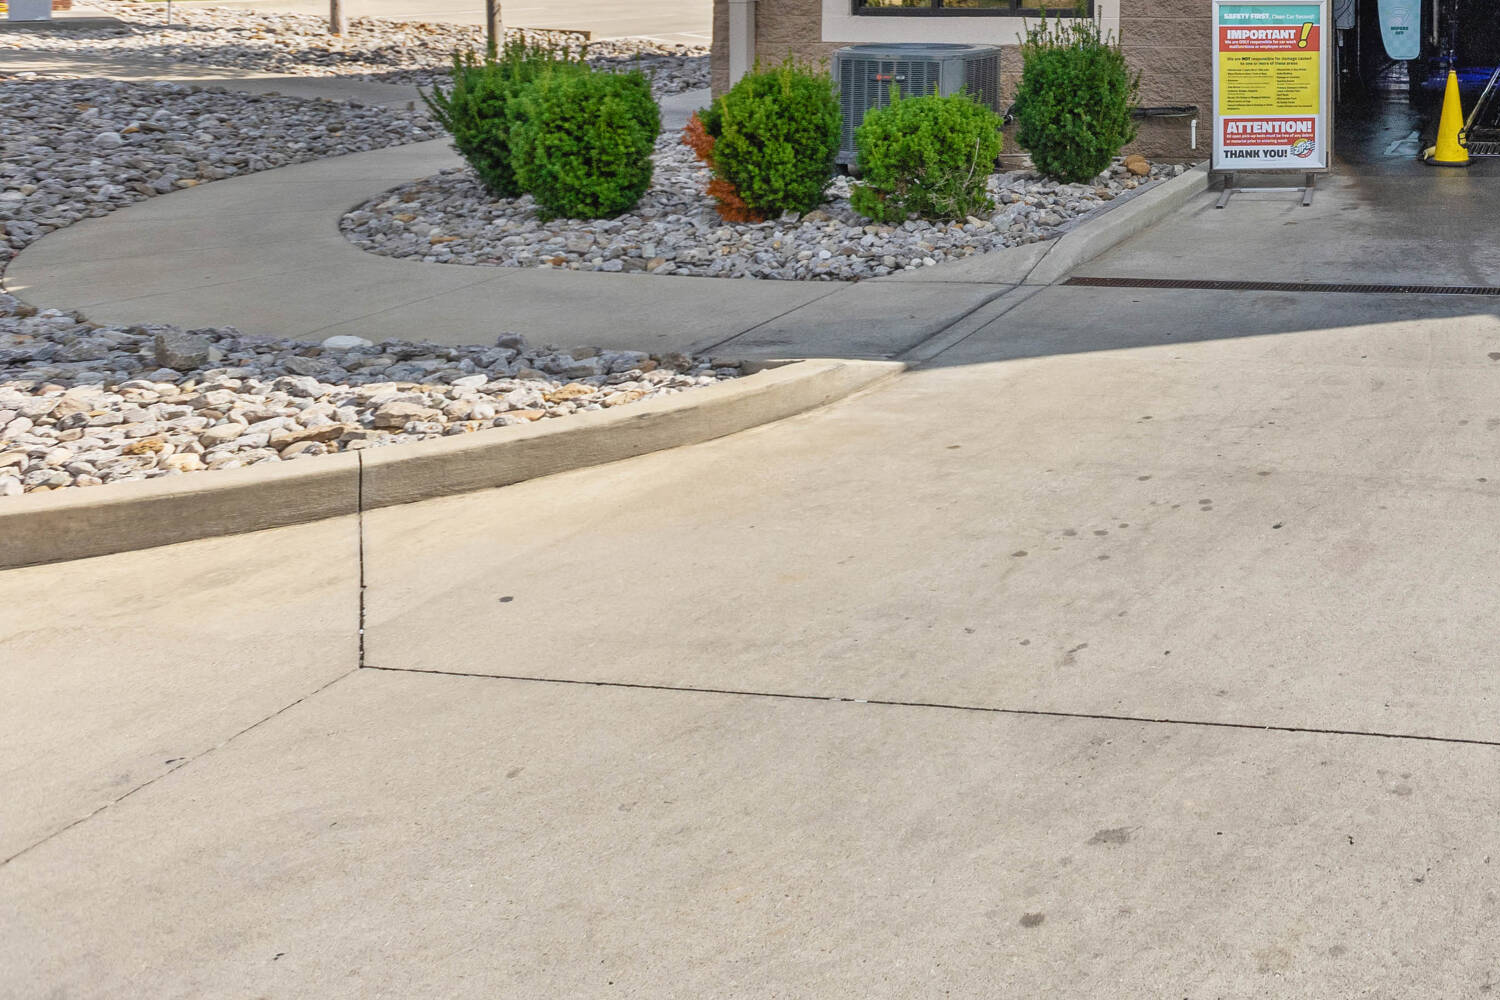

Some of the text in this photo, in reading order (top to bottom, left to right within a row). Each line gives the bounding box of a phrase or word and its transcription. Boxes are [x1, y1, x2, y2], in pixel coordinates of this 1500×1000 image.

[1227, 29, 1296, 39] IMPORTANT
[1227, 121, 1312, 133] ATTENTION!
[1224, 150, 1260, 158] THANK
[1262, 149, 1288, 158] YOU!
